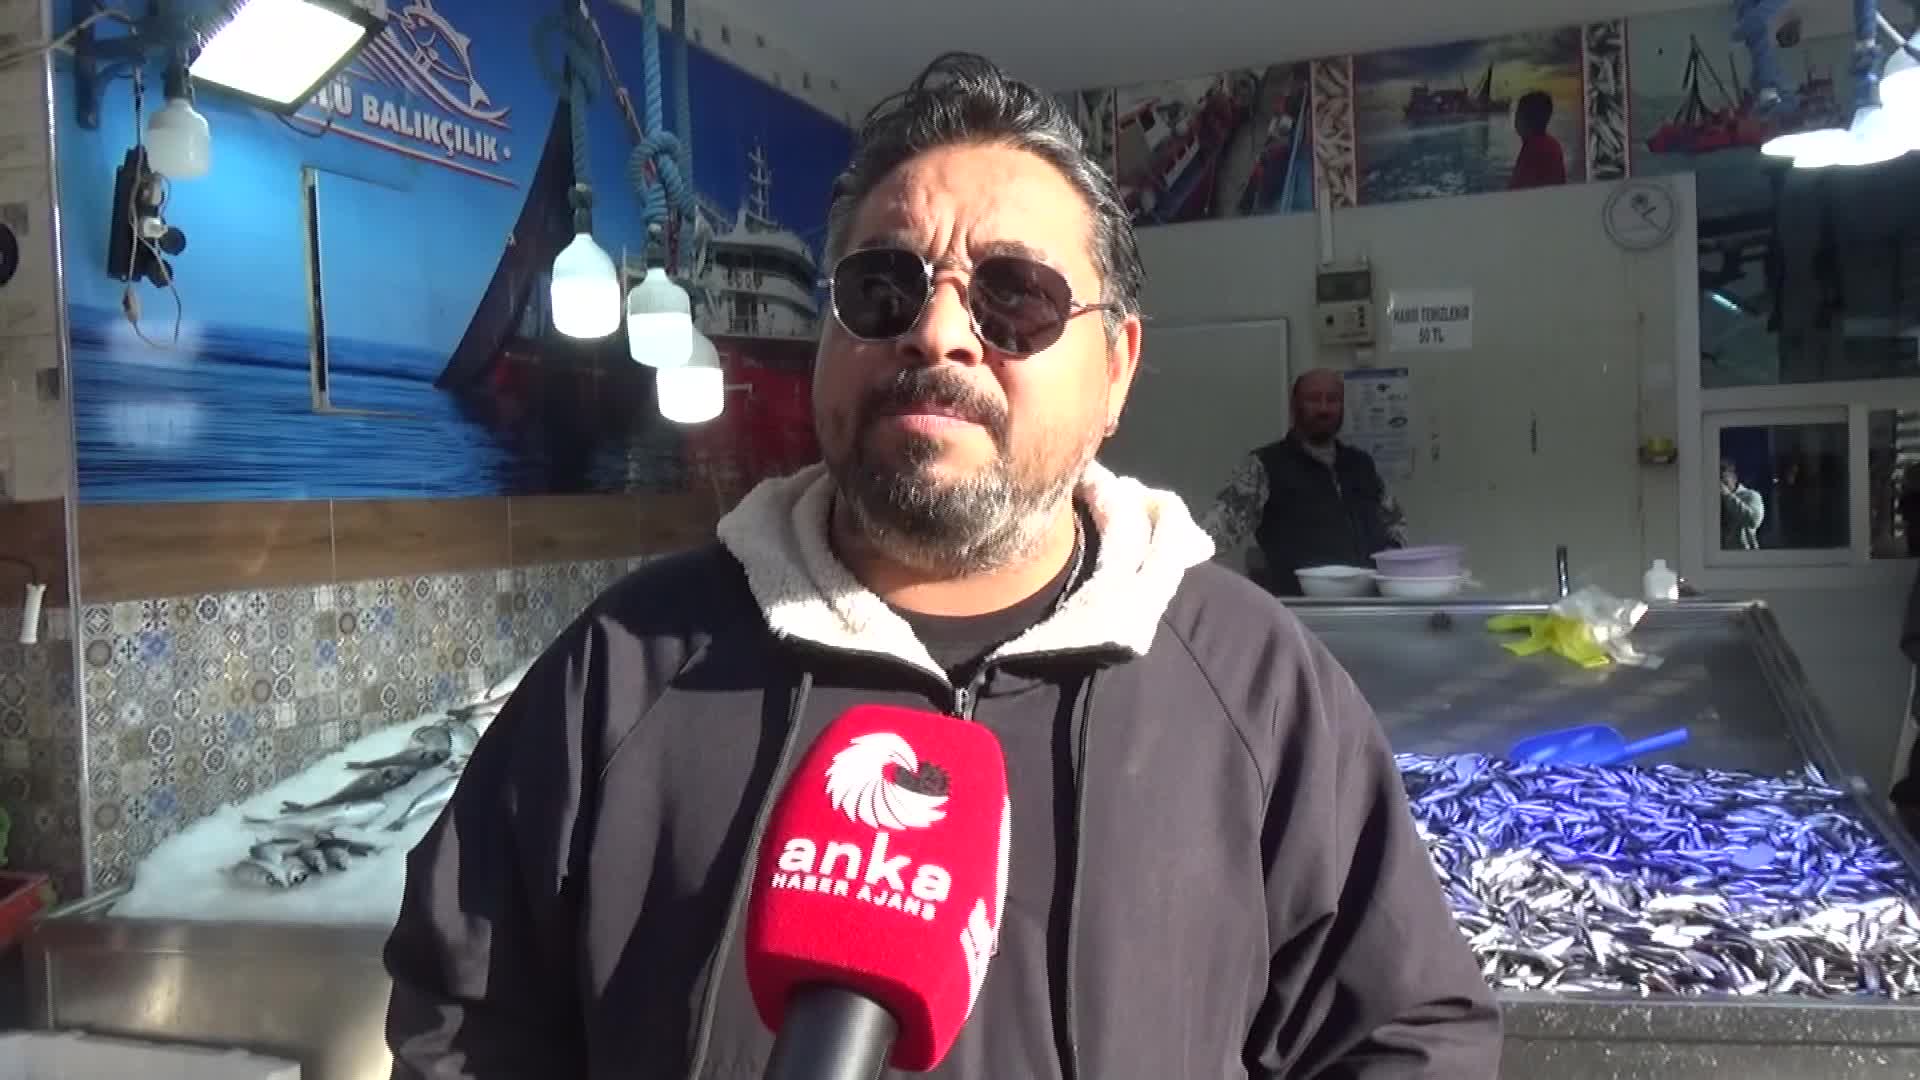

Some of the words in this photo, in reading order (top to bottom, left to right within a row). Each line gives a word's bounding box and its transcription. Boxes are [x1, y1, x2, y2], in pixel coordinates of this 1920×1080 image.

[362, 95, 498, 162] BALIKÇILIK
[1432, 327, 1445, 344] TL
[771, 872, 850, 897] HABER
[778, 831, 952, 902] anka
